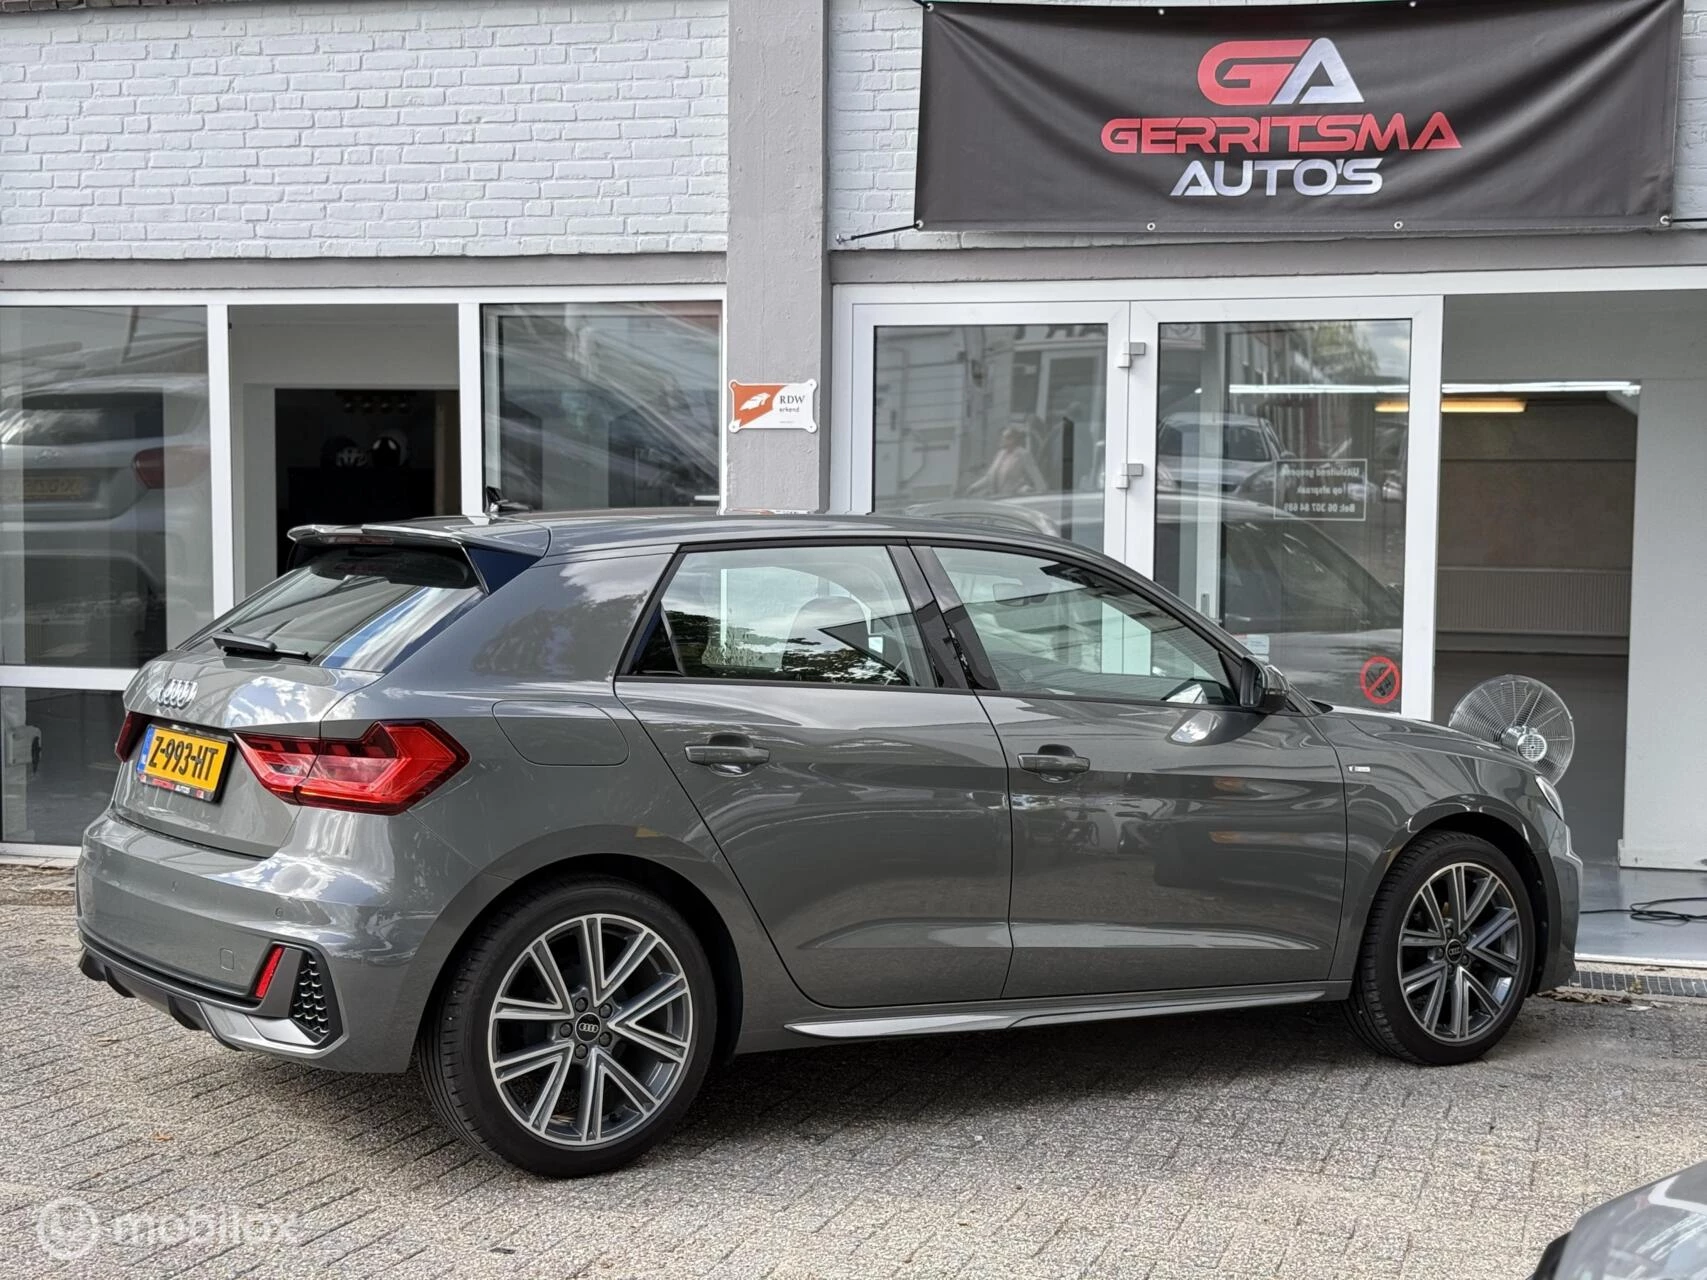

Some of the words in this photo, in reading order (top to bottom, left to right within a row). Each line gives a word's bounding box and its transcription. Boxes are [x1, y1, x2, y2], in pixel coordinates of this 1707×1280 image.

[1197, 37, 1365, 105] GA
[1100, 111, 1462, 154] GERRITSMA
[1170, 158, 1383, 196] AUTO'S
[780, 395, 804, 404] RDW
[148, 736, 218, 781] Z-993-HT
